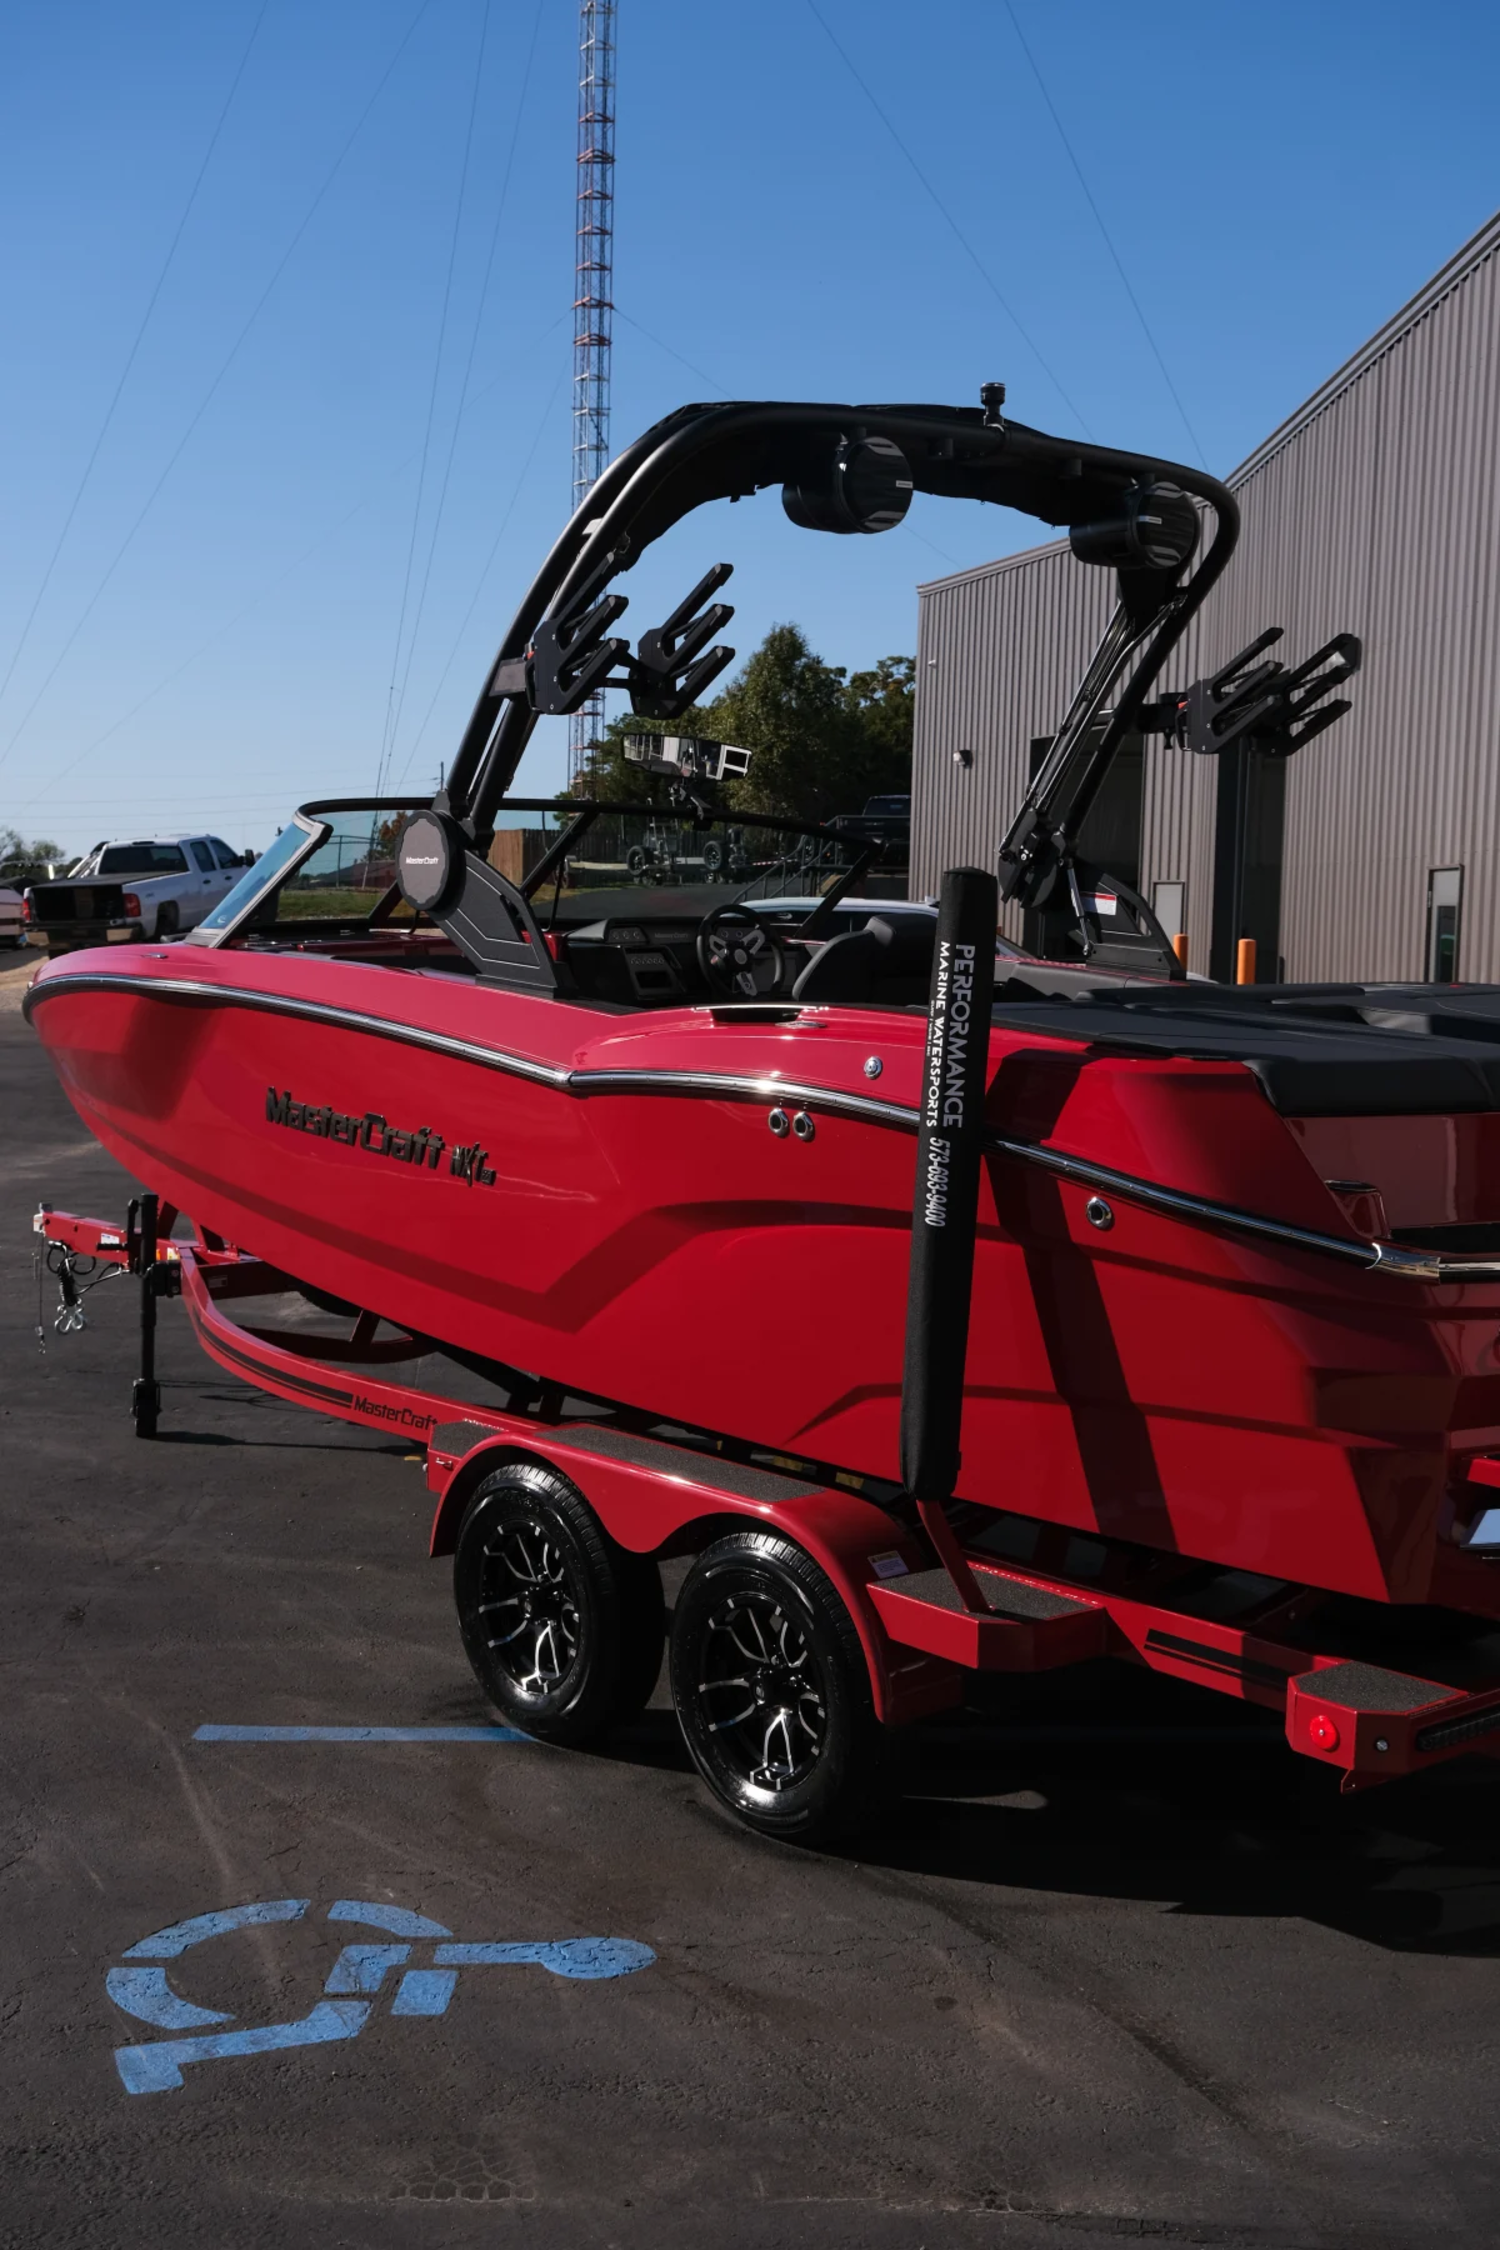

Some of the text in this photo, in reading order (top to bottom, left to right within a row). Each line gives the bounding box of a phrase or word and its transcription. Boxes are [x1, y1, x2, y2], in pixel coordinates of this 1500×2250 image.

[926, 941, 951, 1128] MARINE WATERSPORTS
[942, 944, 976, 1129] PERFORMANCE
[266, 1086, 446, 1170] MasterCraft
[925, 1136, 951, 1227] 573-693-9400
